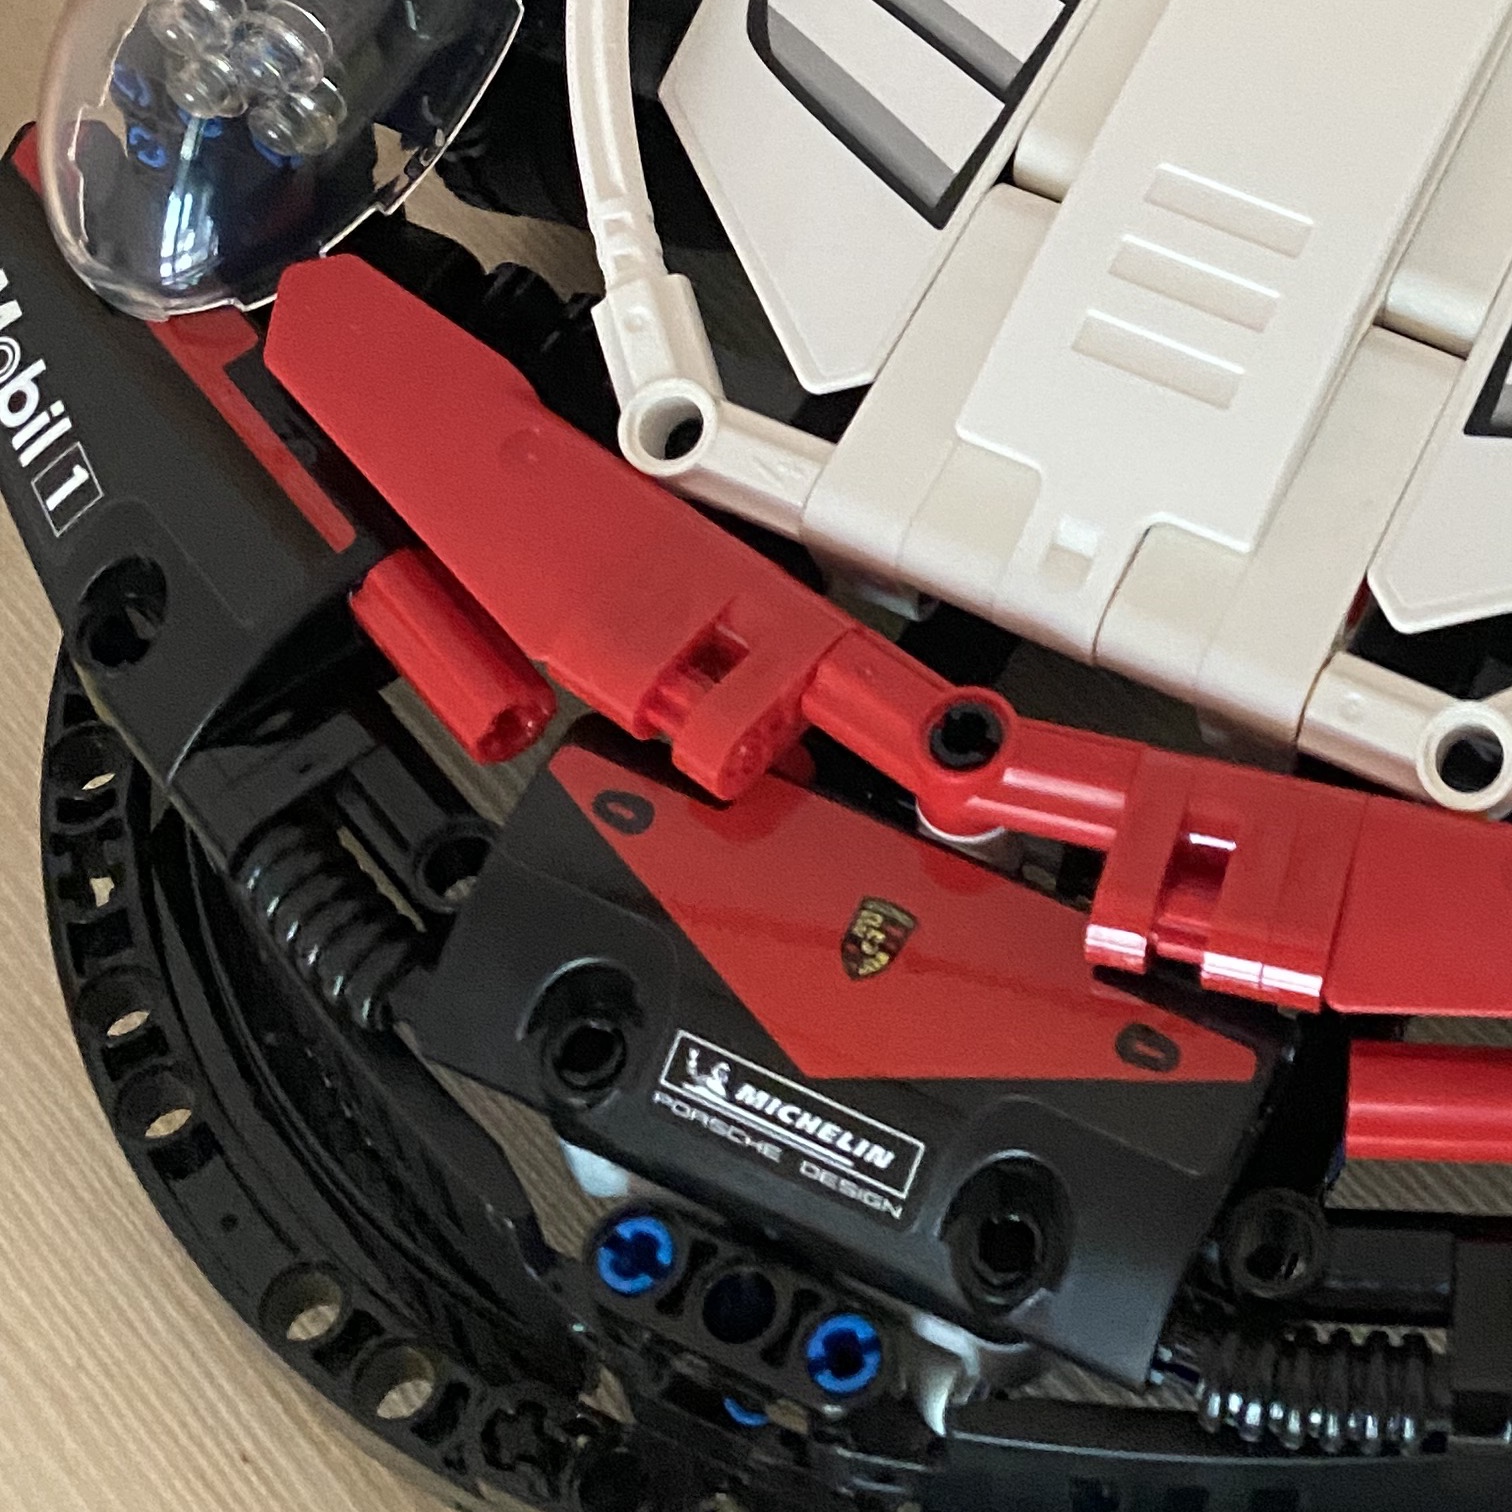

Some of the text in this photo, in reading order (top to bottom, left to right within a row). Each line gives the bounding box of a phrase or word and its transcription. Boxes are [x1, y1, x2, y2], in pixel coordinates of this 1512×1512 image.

[652, 1090, 903, 1220] PORSCHE DESIGN
[734, 1082, 896, 1170] MICHELIN
